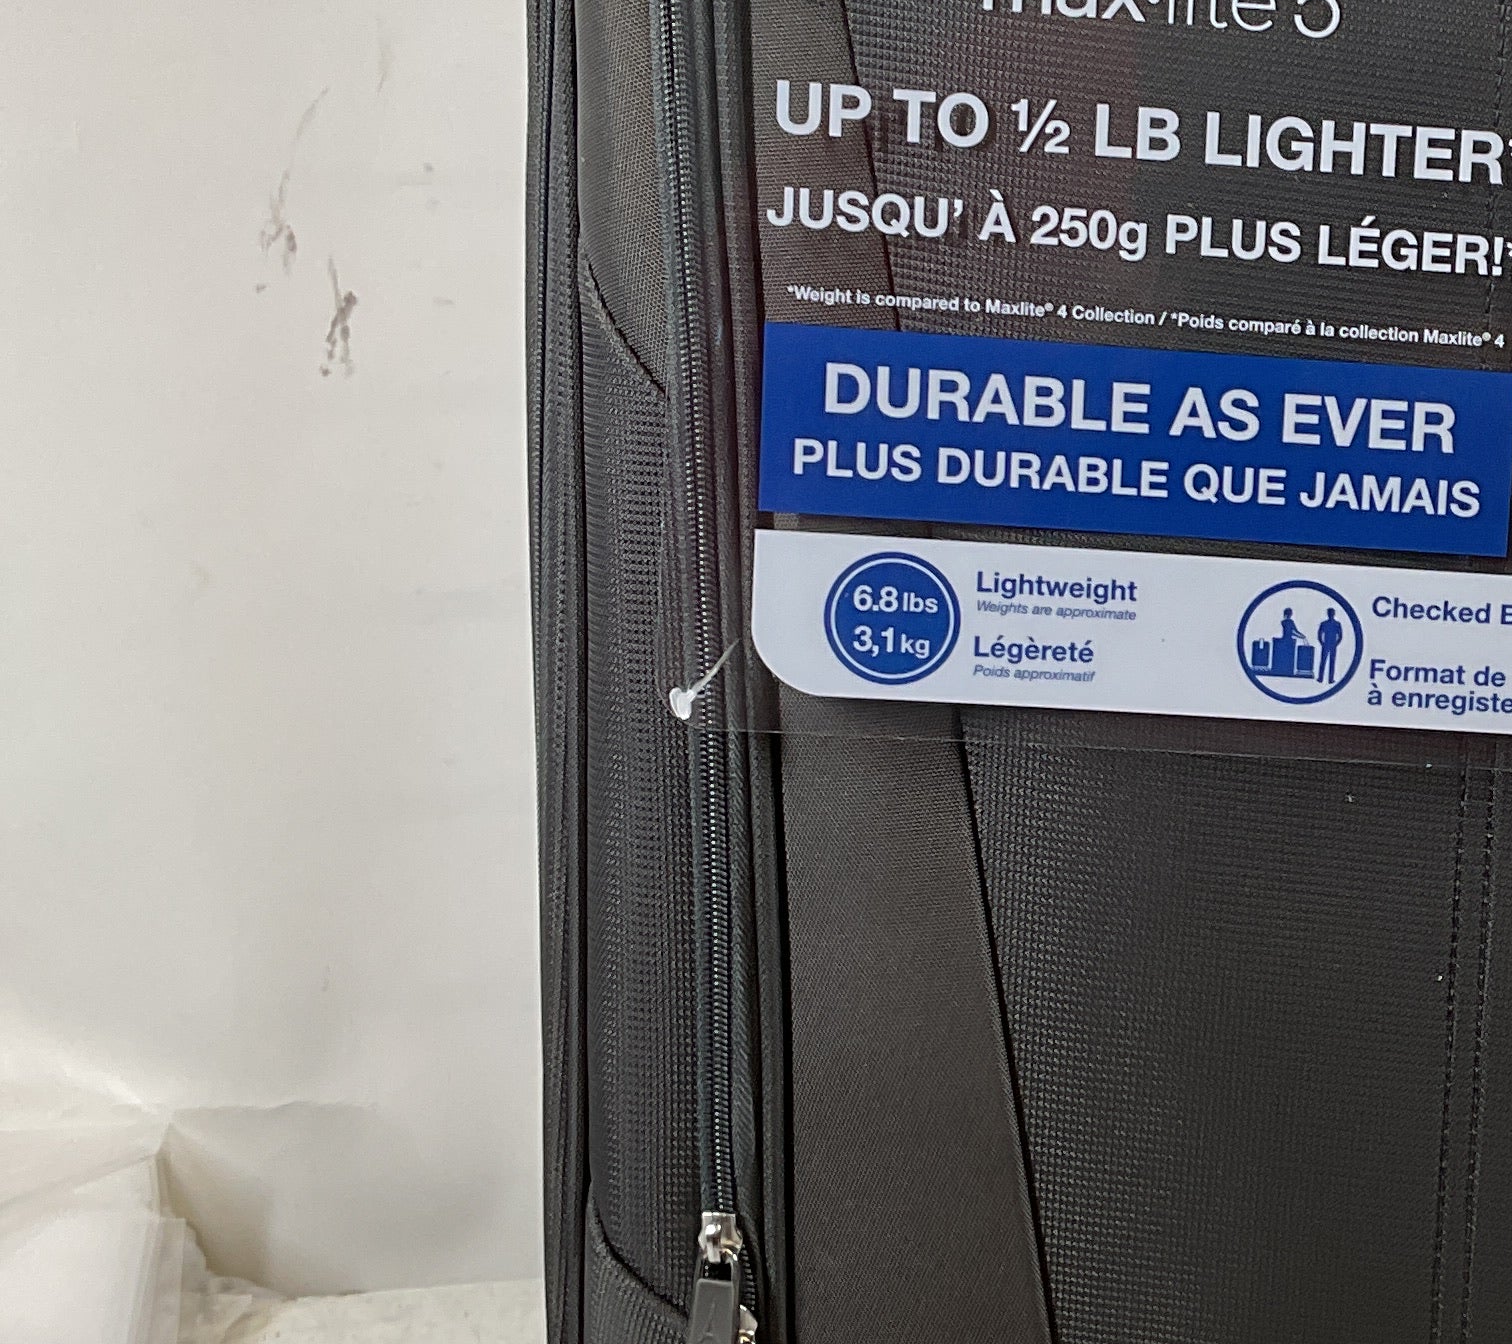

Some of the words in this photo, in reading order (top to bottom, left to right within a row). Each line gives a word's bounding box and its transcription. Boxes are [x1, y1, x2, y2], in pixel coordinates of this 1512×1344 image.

[776, 80, 871, 137] UP
[893, 89, 988, 147] TO
[1095, 104, 1180, 160] LB
[977, 189, 1016, 242] À
[1030, 206, 1147, 261] 250g
[1166, 214, 1300, 262] PLUS
[857, 292, 871, 306] is
[875, 293, 959, 314] compared
[964, 298, 980, 313] to
[1057, 306, 1067, 319] 4
[1072, 305, 1155, 326] Collection
[1228, 315, 1301, 338] comparé
[1305, 319, 1317, 336] à
[1320, 321, 1335, 338] la
[1339, 323, 1419, 344] collection
[1494, 334, 1505, 348] 4
[825, 363, 1150, 433] DURABLE
[1169, 387, 1259, 440] AS
[1283, 394, 1455, 453] EVER
[794, 439, 921, 481] PLUS
[938, 448, 1169, 497] DURABLE
[1184, 464, 1286, 505] QUE
[1300, 472, 1479, 517] JAMAIS
[977, 571, 1137, 604] Lightweight
[977, 600, 1028, 616] Weights
[1032, 606, 1052, 615] are
[1056, 608, 1136, 620] approximate
[1373, 596, 1491, 623] Checked
[974, 635, 1093, 664] Légèreté
[973, 664, 1010, 678] Poids
[1014, 670, 1095, 681] approximatif
[1370, 659, 1465, 688] Format
[1474, 666, 1505, 687] de
[1368, 683, 1382, 705] à
